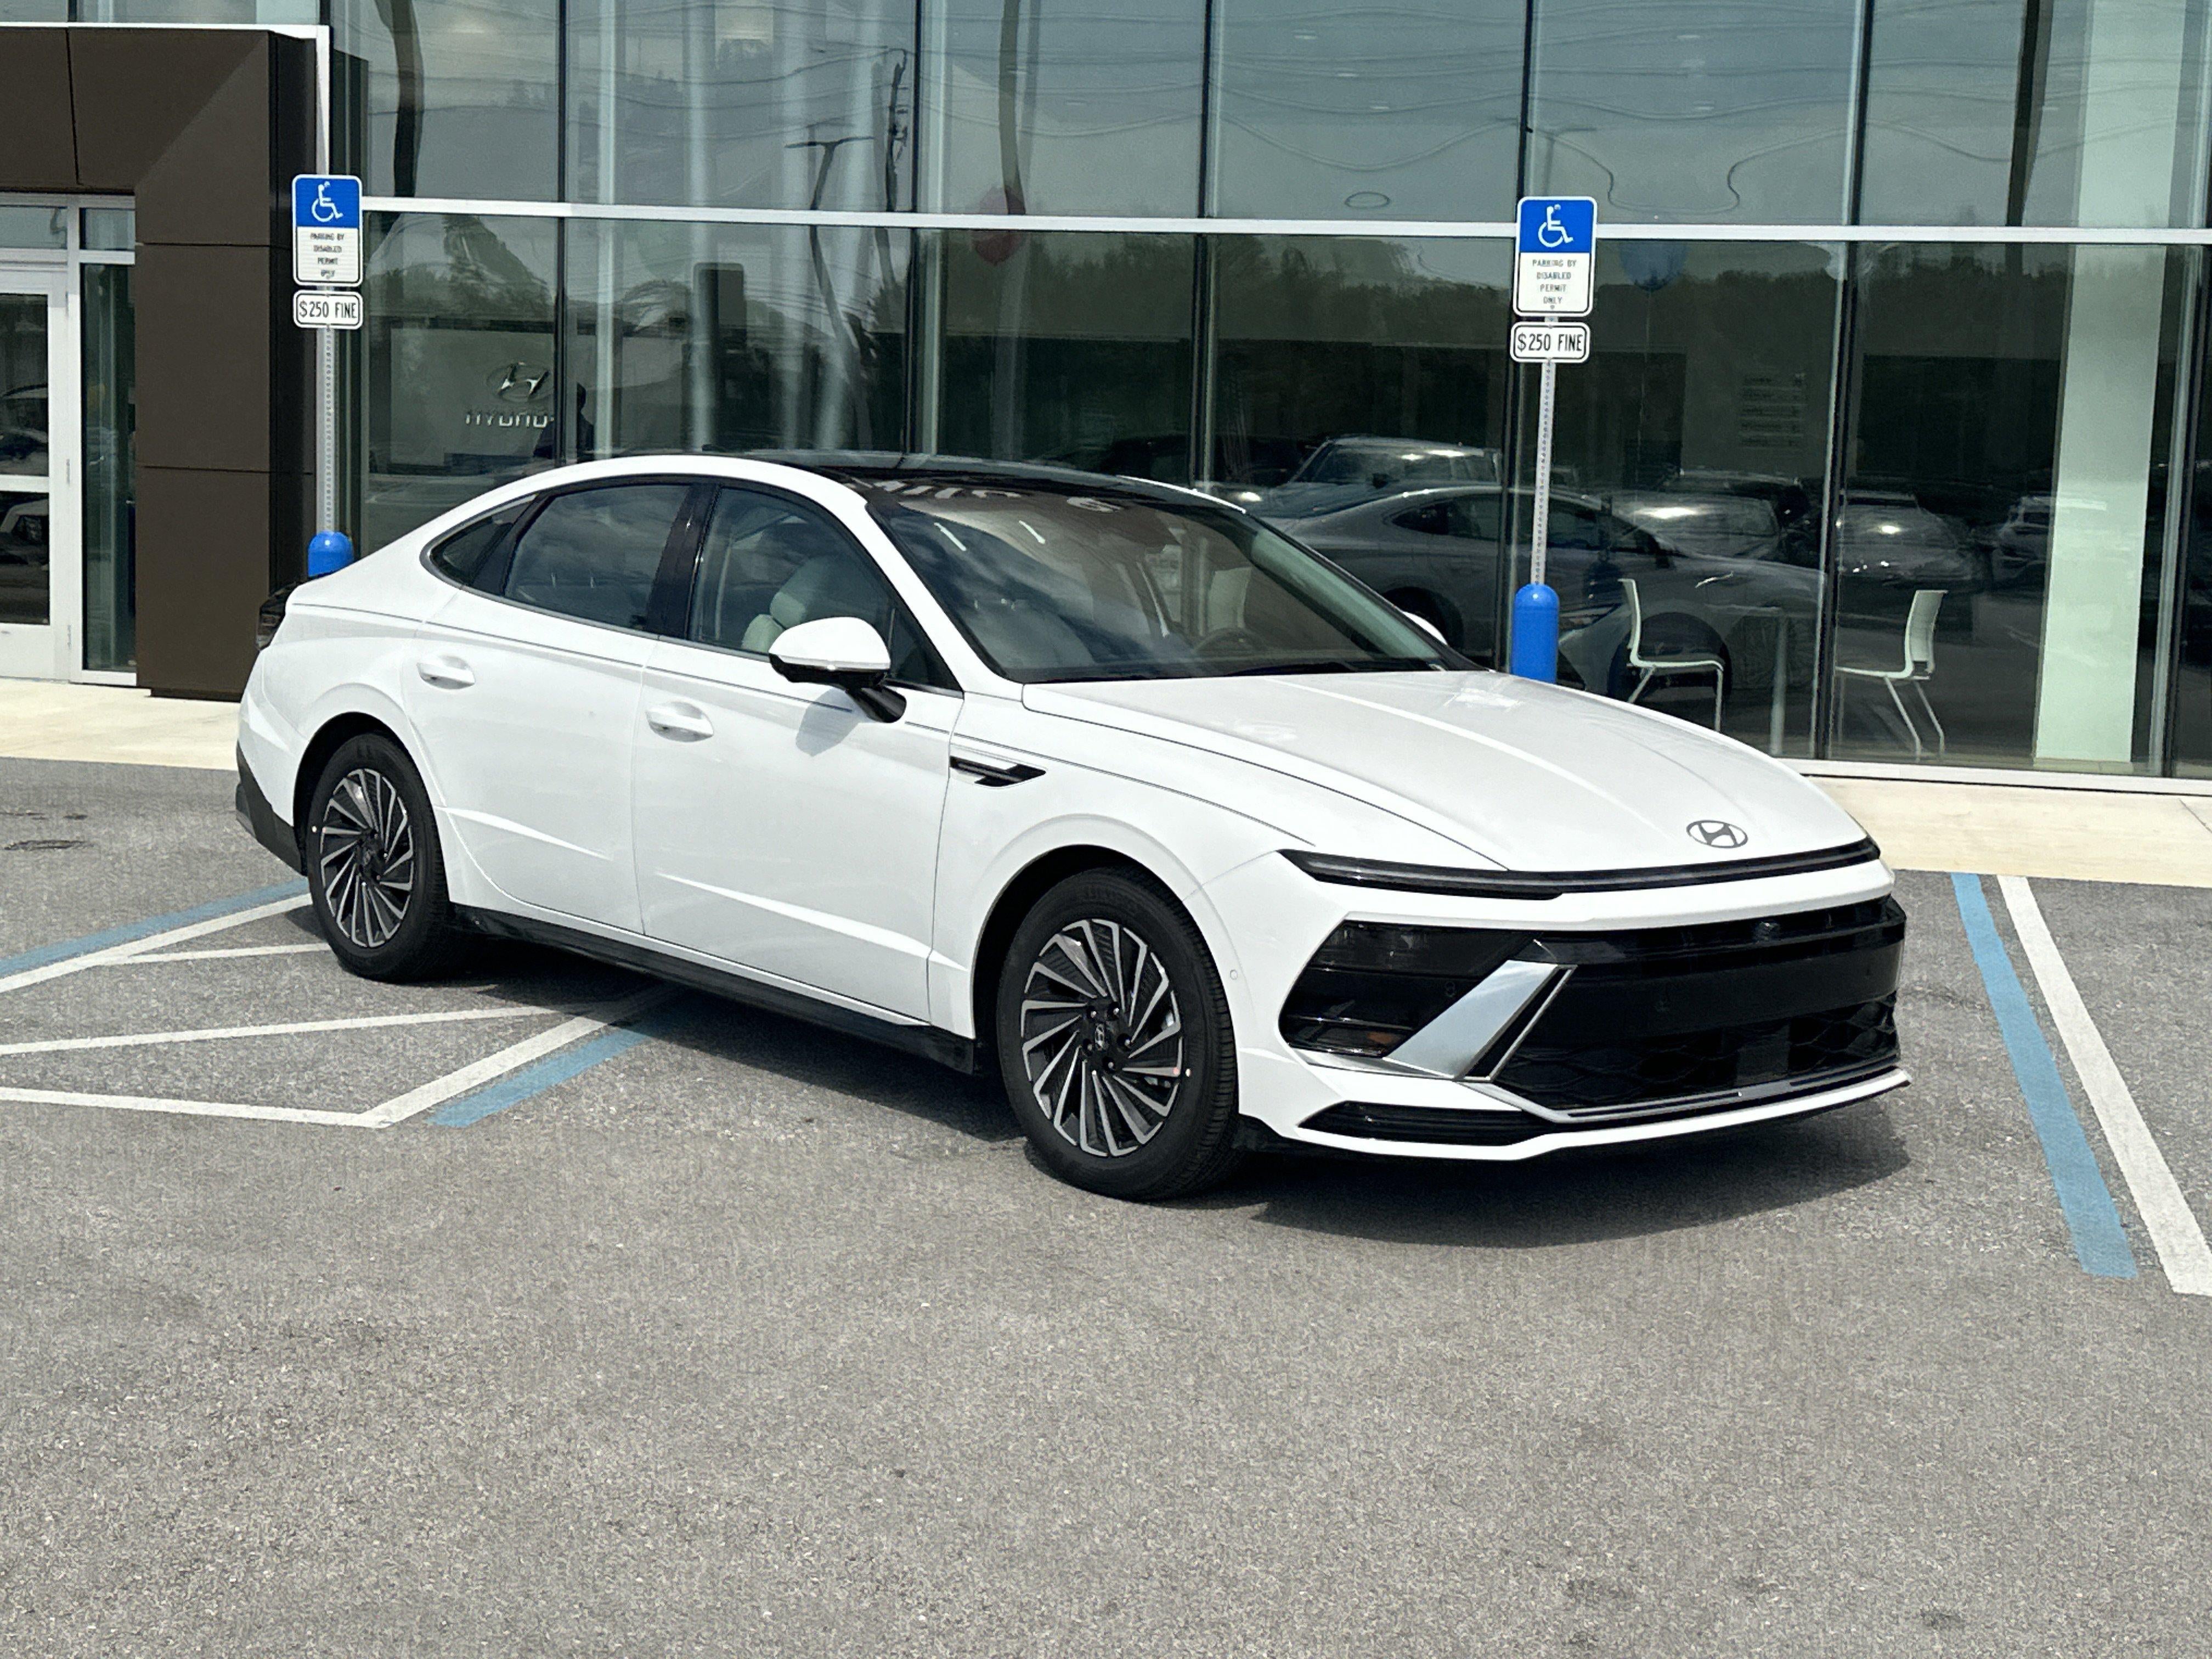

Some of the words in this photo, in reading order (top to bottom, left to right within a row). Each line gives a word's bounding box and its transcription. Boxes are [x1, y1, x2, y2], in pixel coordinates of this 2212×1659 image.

[313, 245, 342, 253] DISABLED
[1532, 259, 1564, 267] PARKING
[1537, 272, 1571, 280] DISABLED
[1540, 284, 1567, 292] PERMIT
[1543, 296, 1563, 304] ONLY
[299, 300, 329, 318] $250
[335, 302, 357, 318] FINE
[1517, 332, 1551, 352] $250
[1558, 334, 1583, 352] FINE
